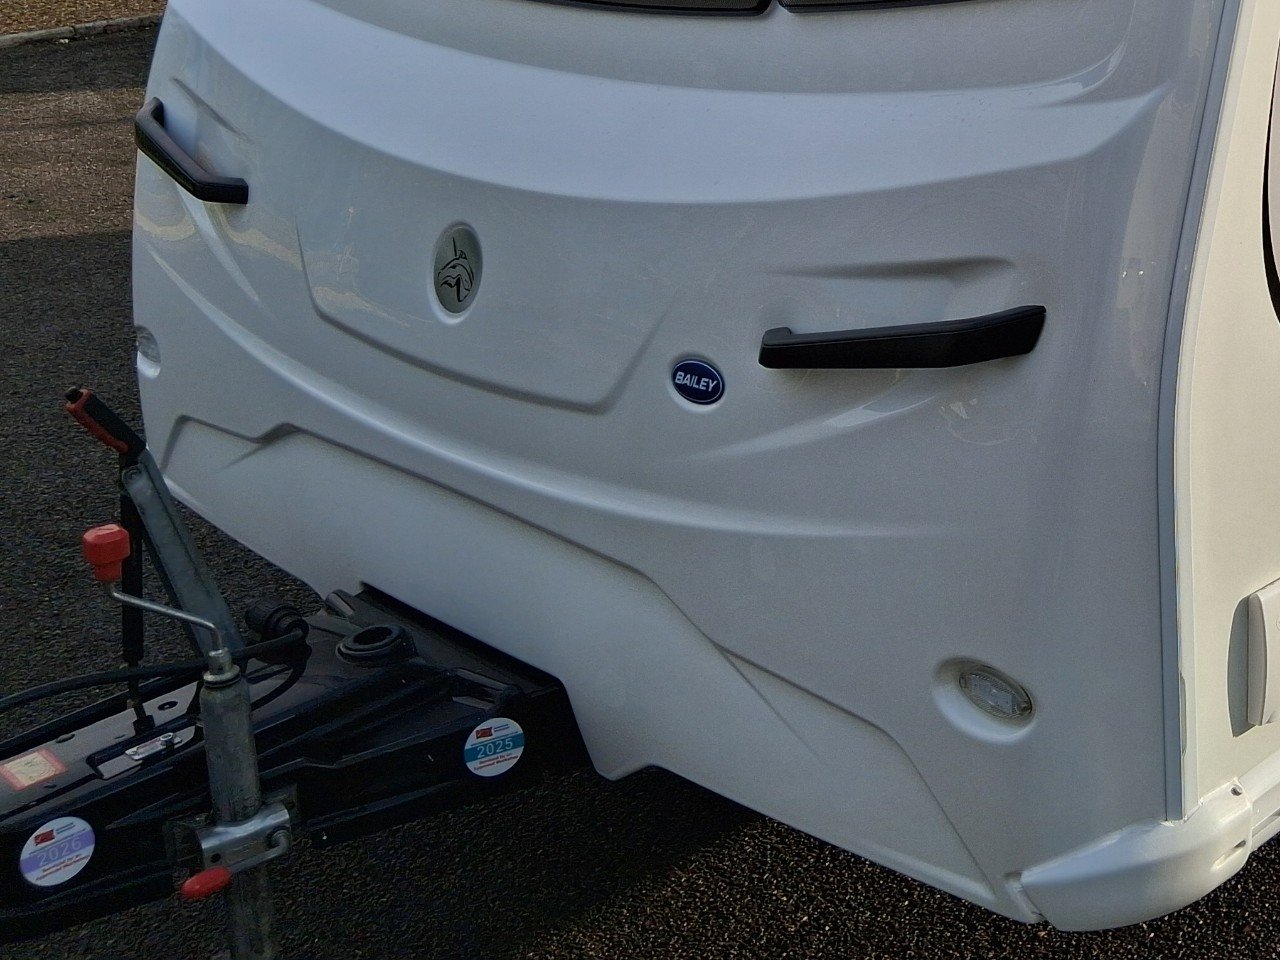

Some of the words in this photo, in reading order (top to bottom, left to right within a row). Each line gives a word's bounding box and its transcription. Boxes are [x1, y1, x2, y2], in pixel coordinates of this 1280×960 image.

[674, 371, 718, 392] BAILEY
[477, 737, 513, 758] 2025
[37, 836, 81, 866] 2026
